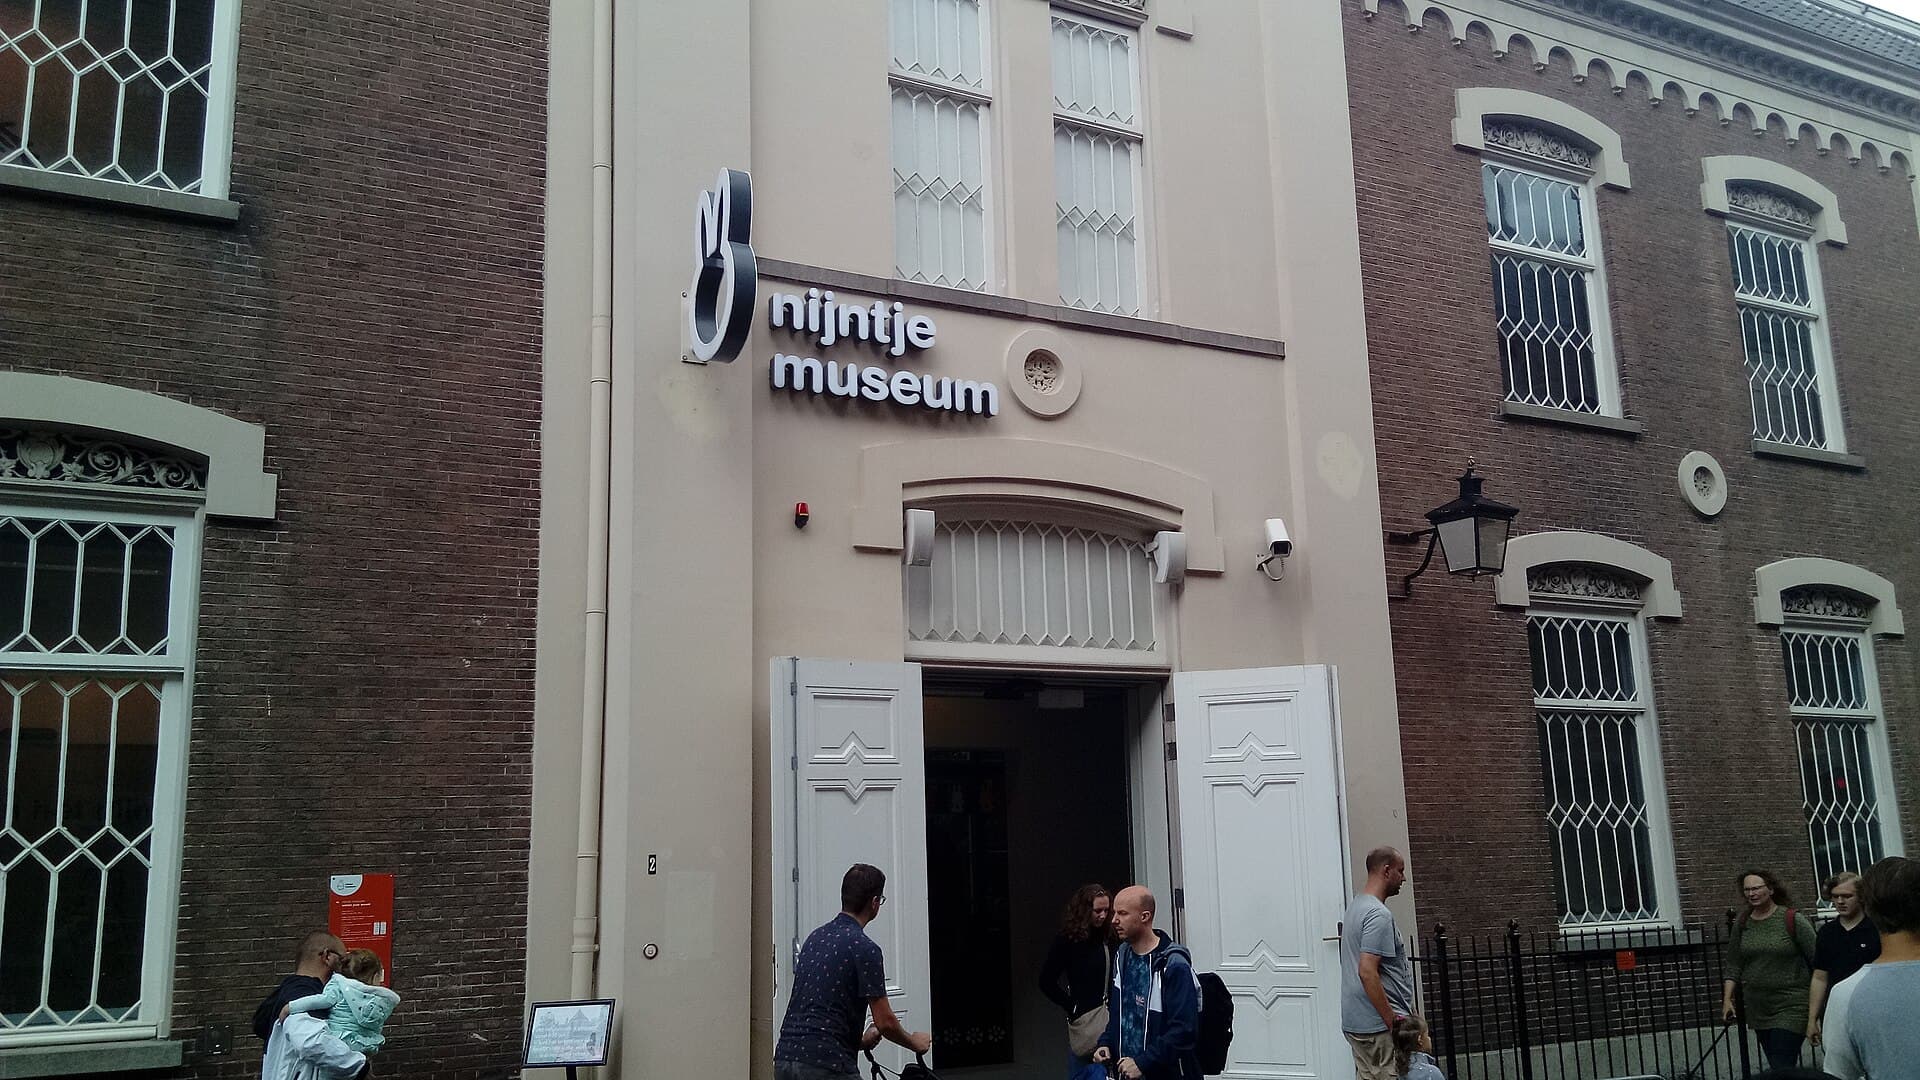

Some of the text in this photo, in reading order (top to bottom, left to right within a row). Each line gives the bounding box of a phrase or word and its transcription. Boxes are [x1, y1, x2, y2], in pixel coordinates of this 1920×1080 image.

[770, 288, 936, 356] nijntje
[770, 353, 999, 416] museum
[649, 857, 656, 872] 2
